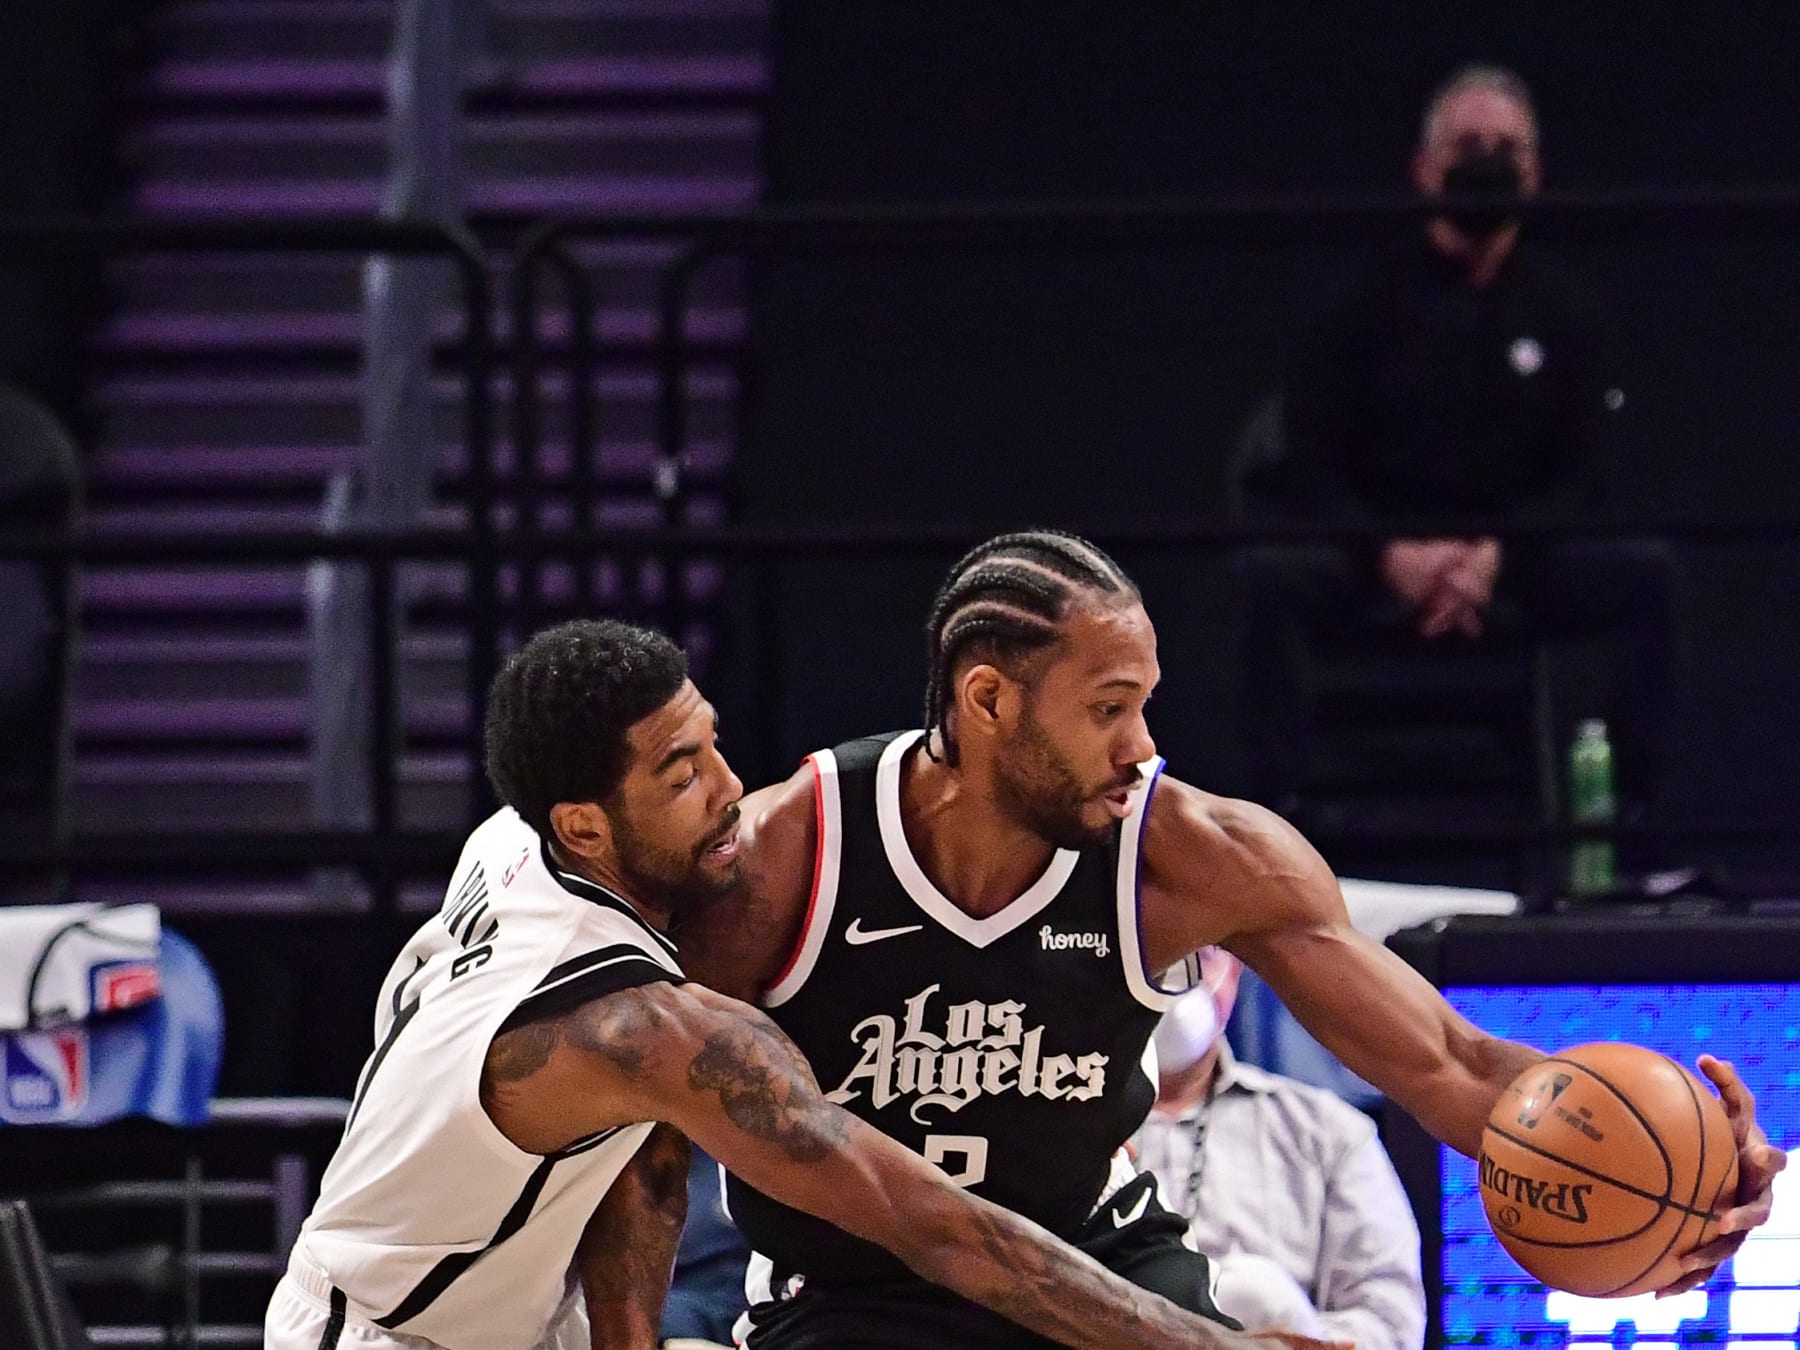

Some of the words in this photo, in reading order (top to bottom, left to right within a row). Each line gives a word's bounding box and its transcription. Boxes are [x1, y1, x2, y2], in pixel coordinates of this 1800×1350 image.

[1039, 925, 1110, 957] honey
[895, 983, 1027, 1048] Los
[822, 1014, 1109, 1126] Angeles
